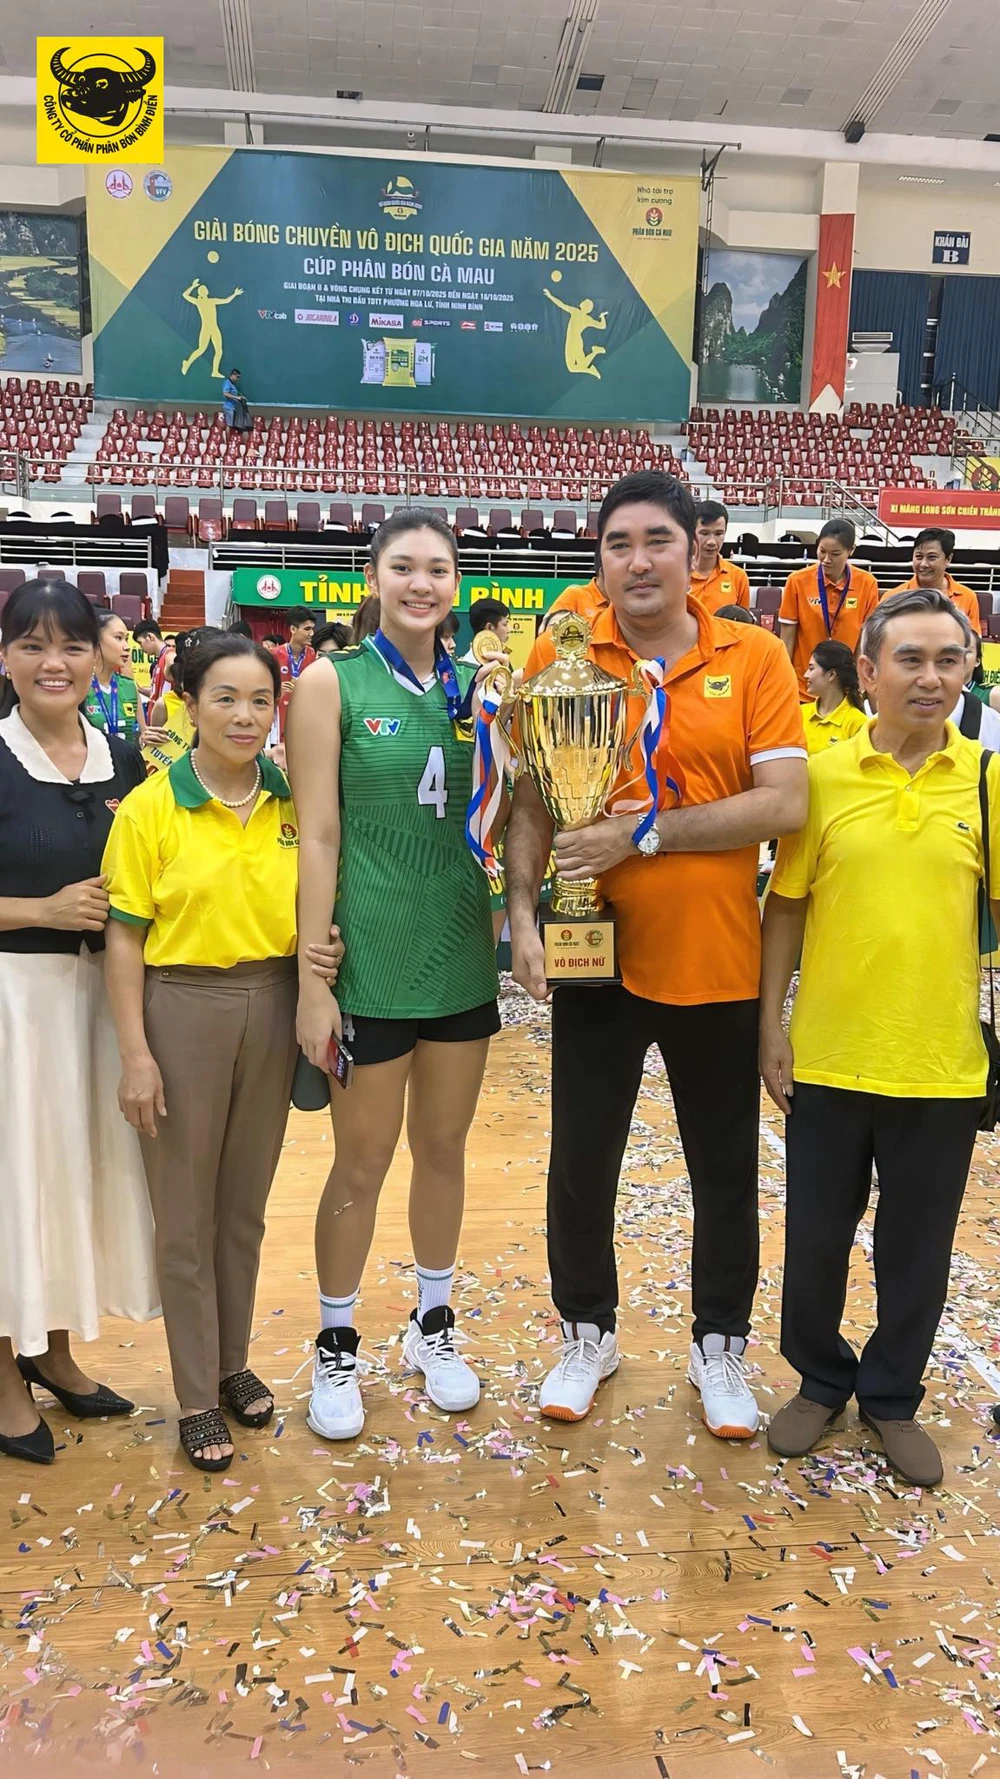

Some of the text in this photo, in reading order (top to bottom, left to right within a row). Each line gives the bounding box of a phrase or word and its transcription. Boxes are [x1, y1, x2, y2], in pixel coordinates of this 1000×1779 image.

[194, 217, 599, 263] GIẢI BÓNG CHUYỀN VÔ ĐỊCH QUỐC GIA NĂM 2025
[935, 234, 969, 248] KHÁN ĐÀI
[942, 249, 959, 263] B
[303, 255, 495, 285] CÚP PHÂN BÓN CÀ MAU
[283, 282, 297, 290] GIAI
[323, 284, 329, 292] &
[330, 284, 348, 293] VÒNG
[349, 285, 371, 294] CHUNG
[372, 285, 383, 295] KẾT
[394, 287, 411, 296] NGÀY
[462, 291, 479, 300] NGÀY
[326, 294, 340, 303] NHÀ
[342, 296, 352, 304] THI
[424, 319, 451, 327] SPORTS
[899, 503, 920, 514] MĂNG
[922, 505, 940, 515] LONG
[941, 505, 957, 516] SƠN
[957, 504, 978, 516] CHIẾN
[363, 717, 401, 736] VTV
[166, 729, 183, 746] CÔNG
[417, 744, 449, 819] 4
[554, 955, 606, 970] VÔ ĐỊCH NỮ
[342, 1011, 356, 1042] 4
